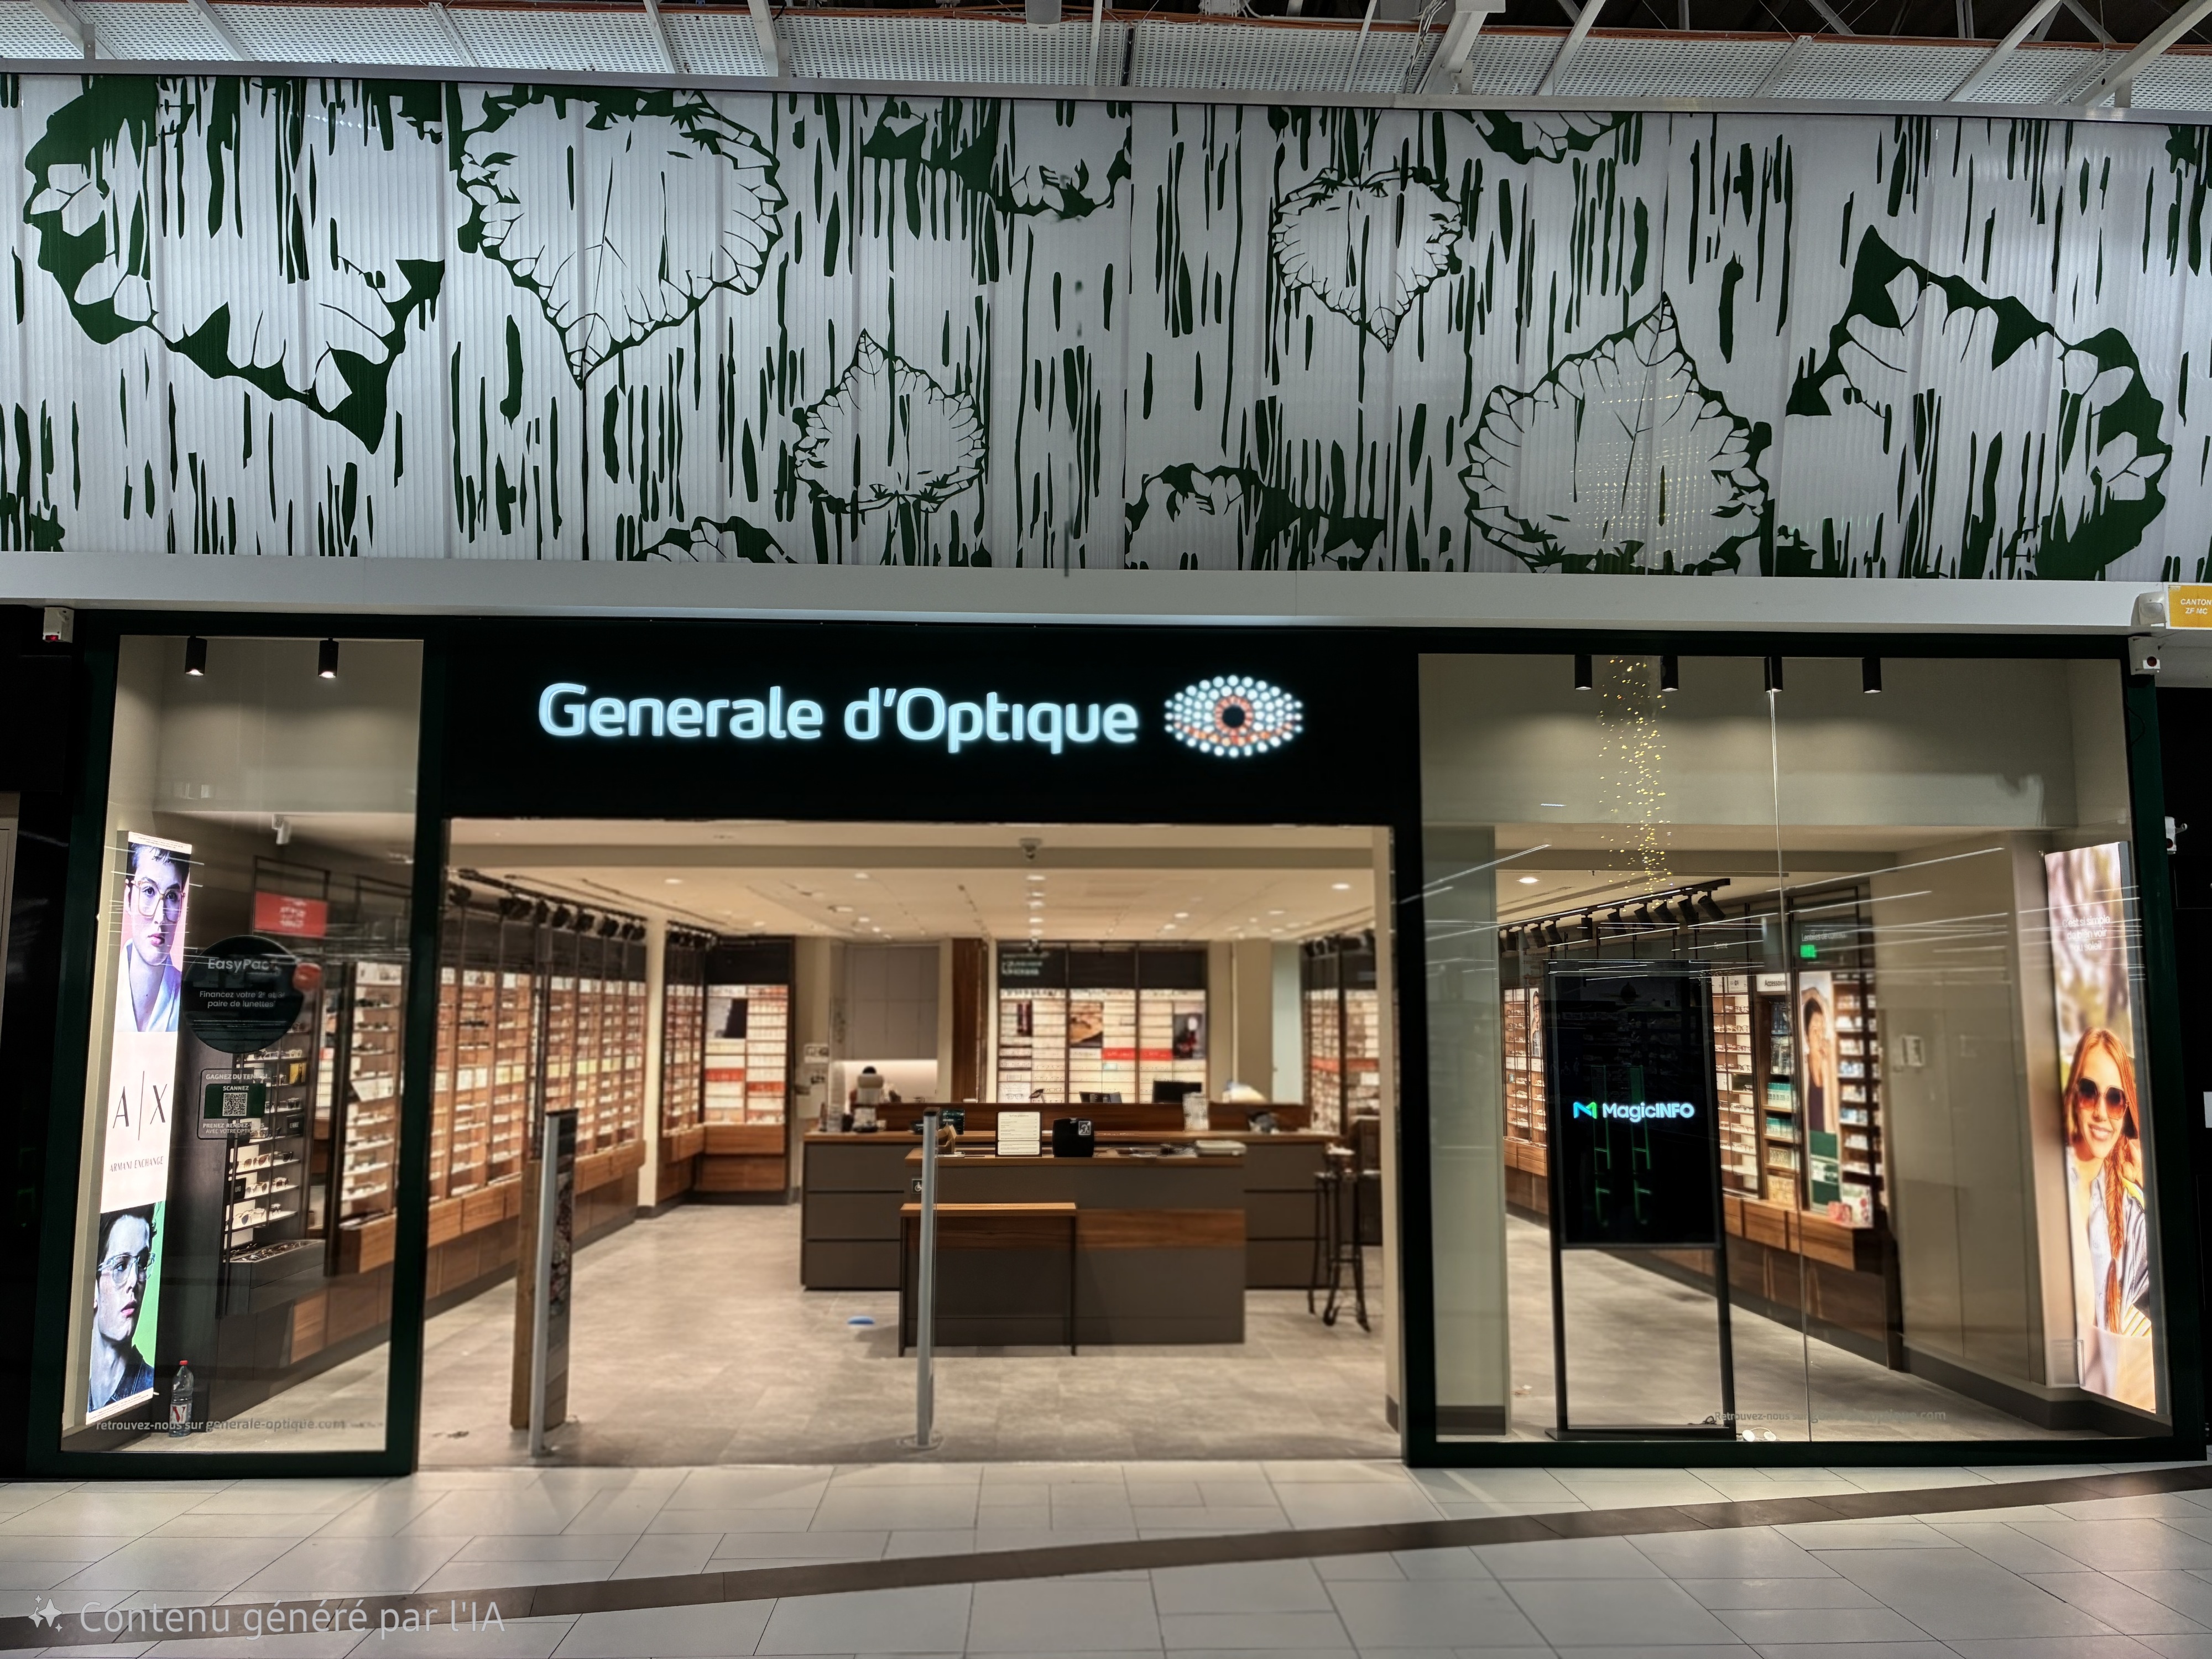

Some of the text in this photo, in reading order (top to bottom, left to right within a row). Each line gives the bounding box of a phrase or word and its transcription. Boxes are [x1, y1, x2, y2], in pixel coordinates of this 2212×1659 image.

[539, 683, 1139, 754] Generale d'Optique
[2086, 914, 2110, 926] simple
[2093, 927, 2107, 938] voir
[1603, 1102, 1695, 1123] MagicINFO
[109, 1156, 164, 1172] ARMANI EXCHANGE
[1714, 1412, 1790, 1421] Retrouvez-nous
[184, 1421, 204, 1430] sur
